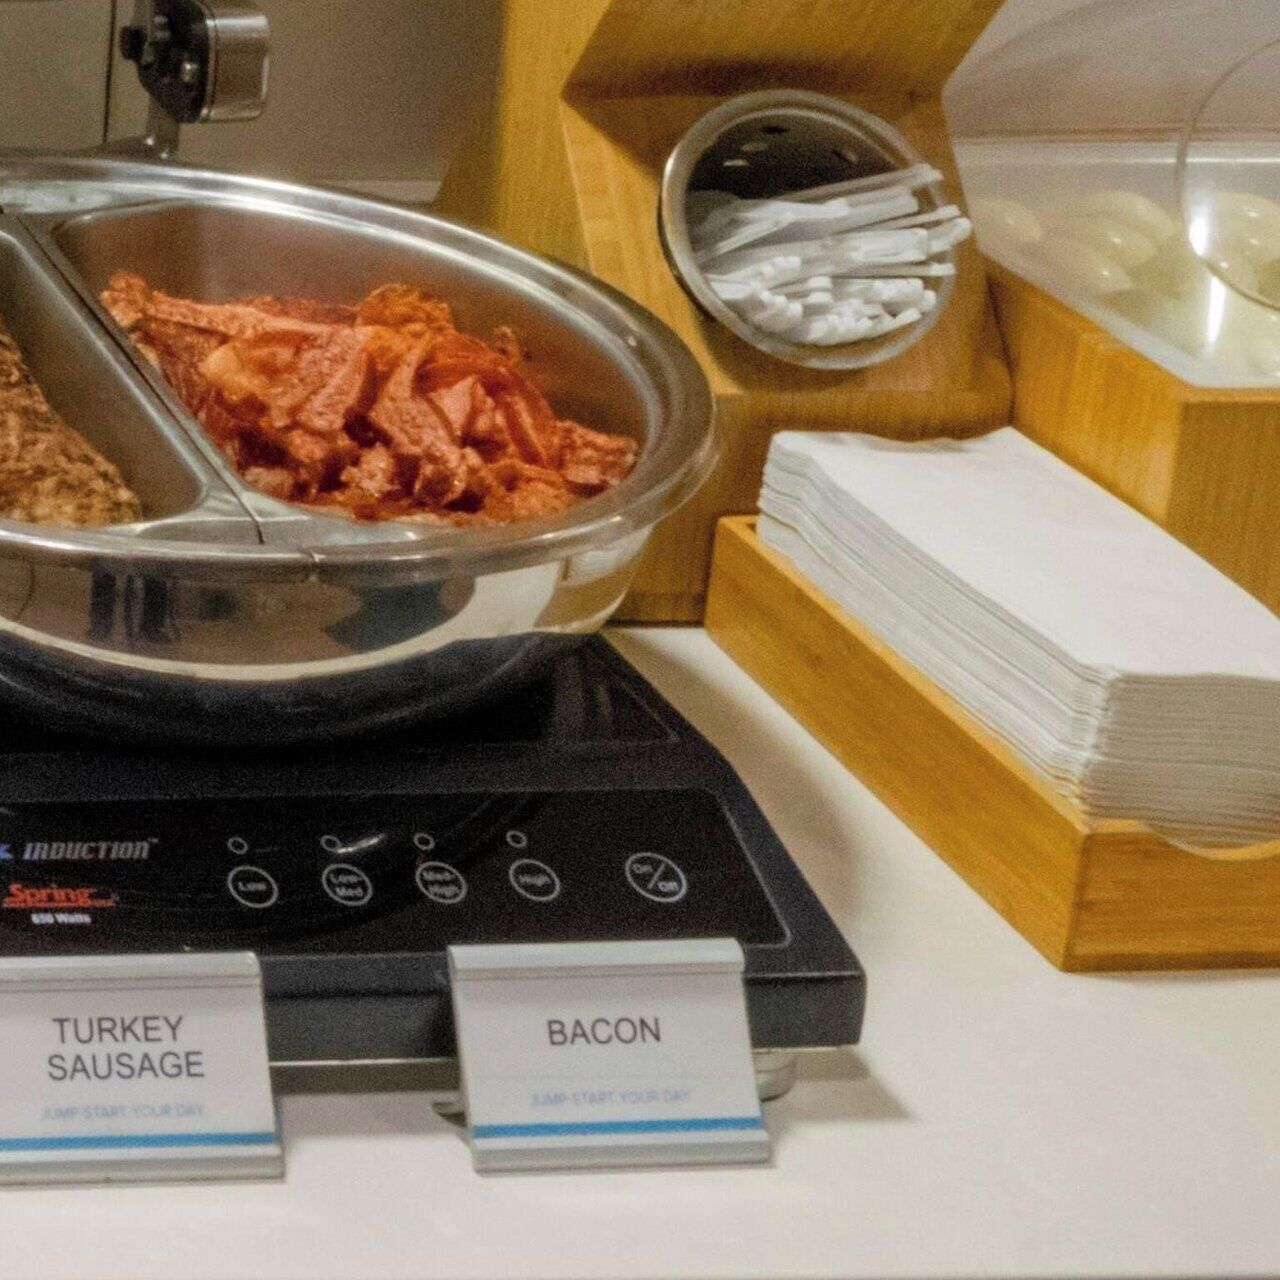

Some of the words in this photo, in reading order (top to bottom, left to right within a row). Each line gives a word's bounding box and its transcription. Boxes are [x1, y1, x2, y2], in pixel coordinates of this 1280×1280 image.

[22, 841, 150, 860] INDUCTION
[52, 1015, 183, 1044] TURKEY
[547, 1017, 662, 1046] BACON
[47, 1051, 205, 1081] SAUSAGE
